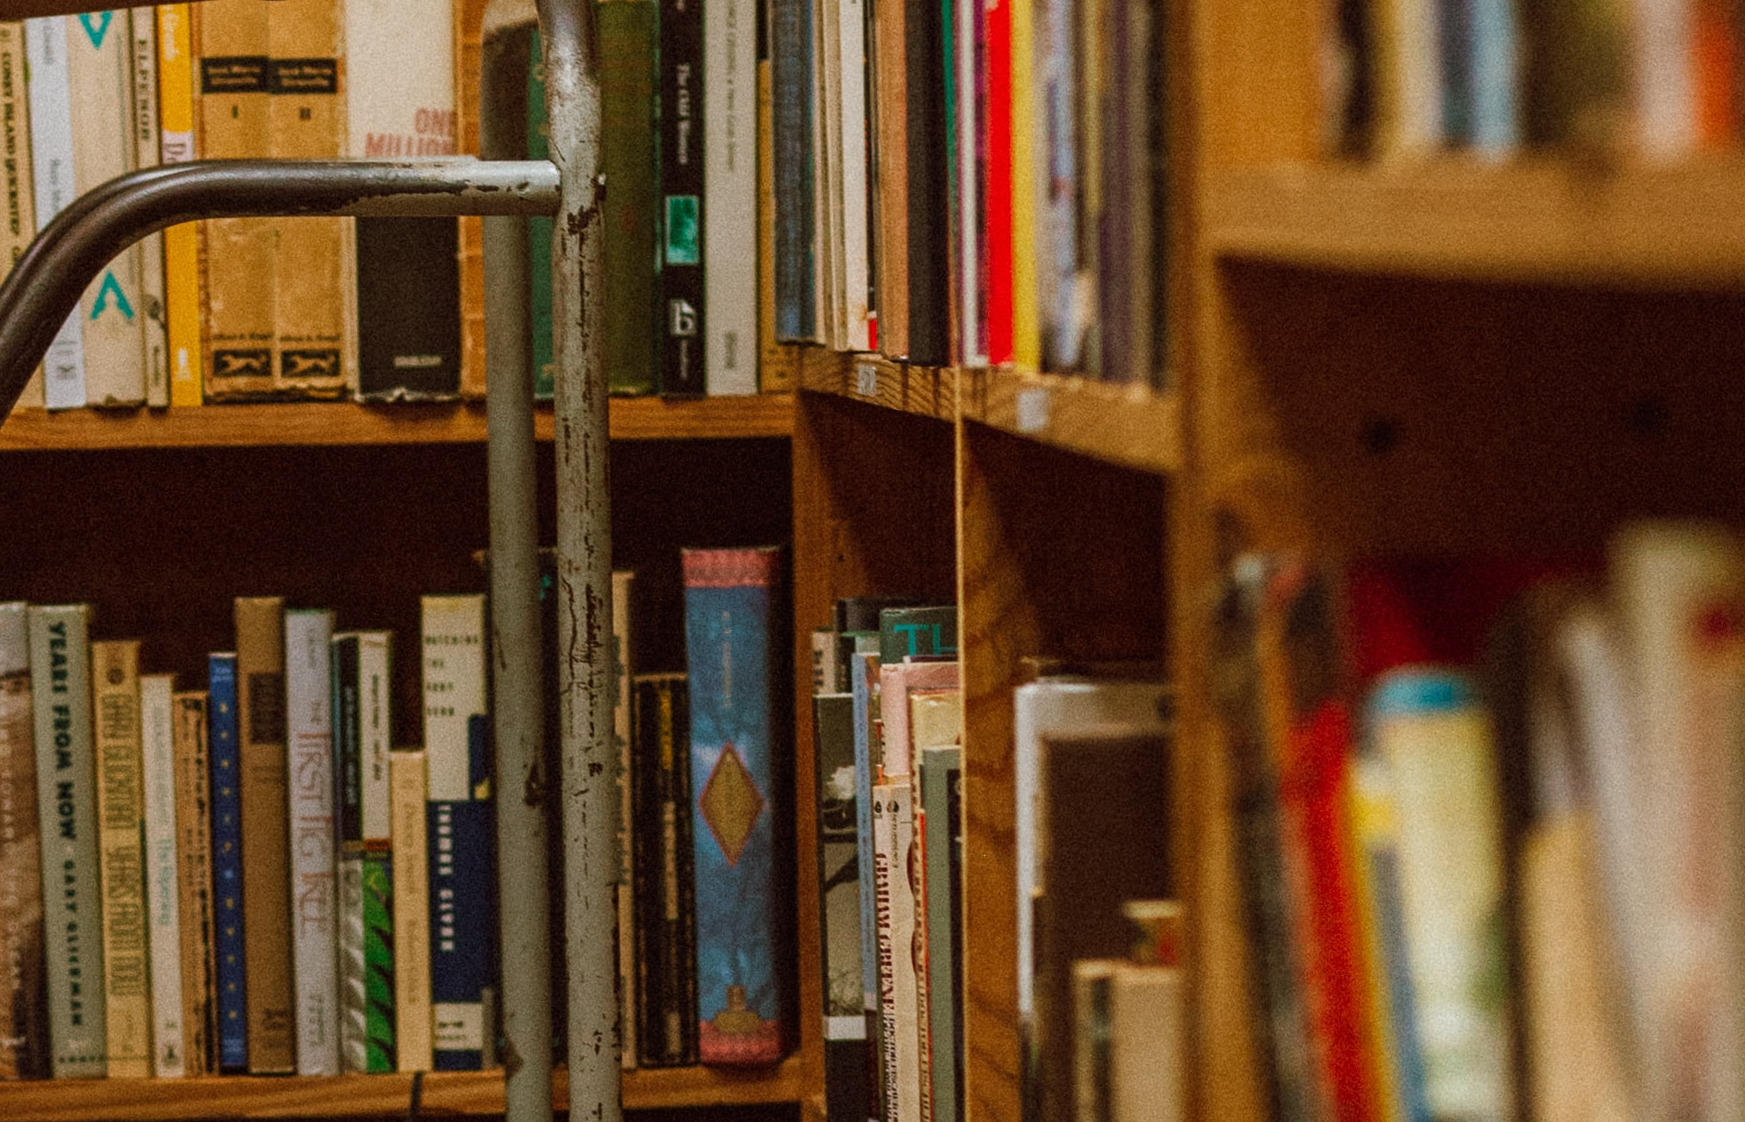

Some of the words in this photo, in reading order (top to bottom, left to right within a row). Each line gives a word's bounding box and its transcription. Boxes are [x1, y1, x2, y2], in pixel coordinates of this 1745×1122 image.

[1, 51, 16, 101] CONEY
[136, 38, 152, 143] ELPENOR
[3, 103, 18, 155] ISLAND
[52, 704, 75, 772] FROM
[295, 732, 332, 802] FIRST
[55, 781, 78, 841] NOW
[297, 814, 334, 857] FIG
[298, 870, 333, 939] TREE
[876, 852, 892, 929] GRAHAM
[878, 934, 895, 1011] GREENE
